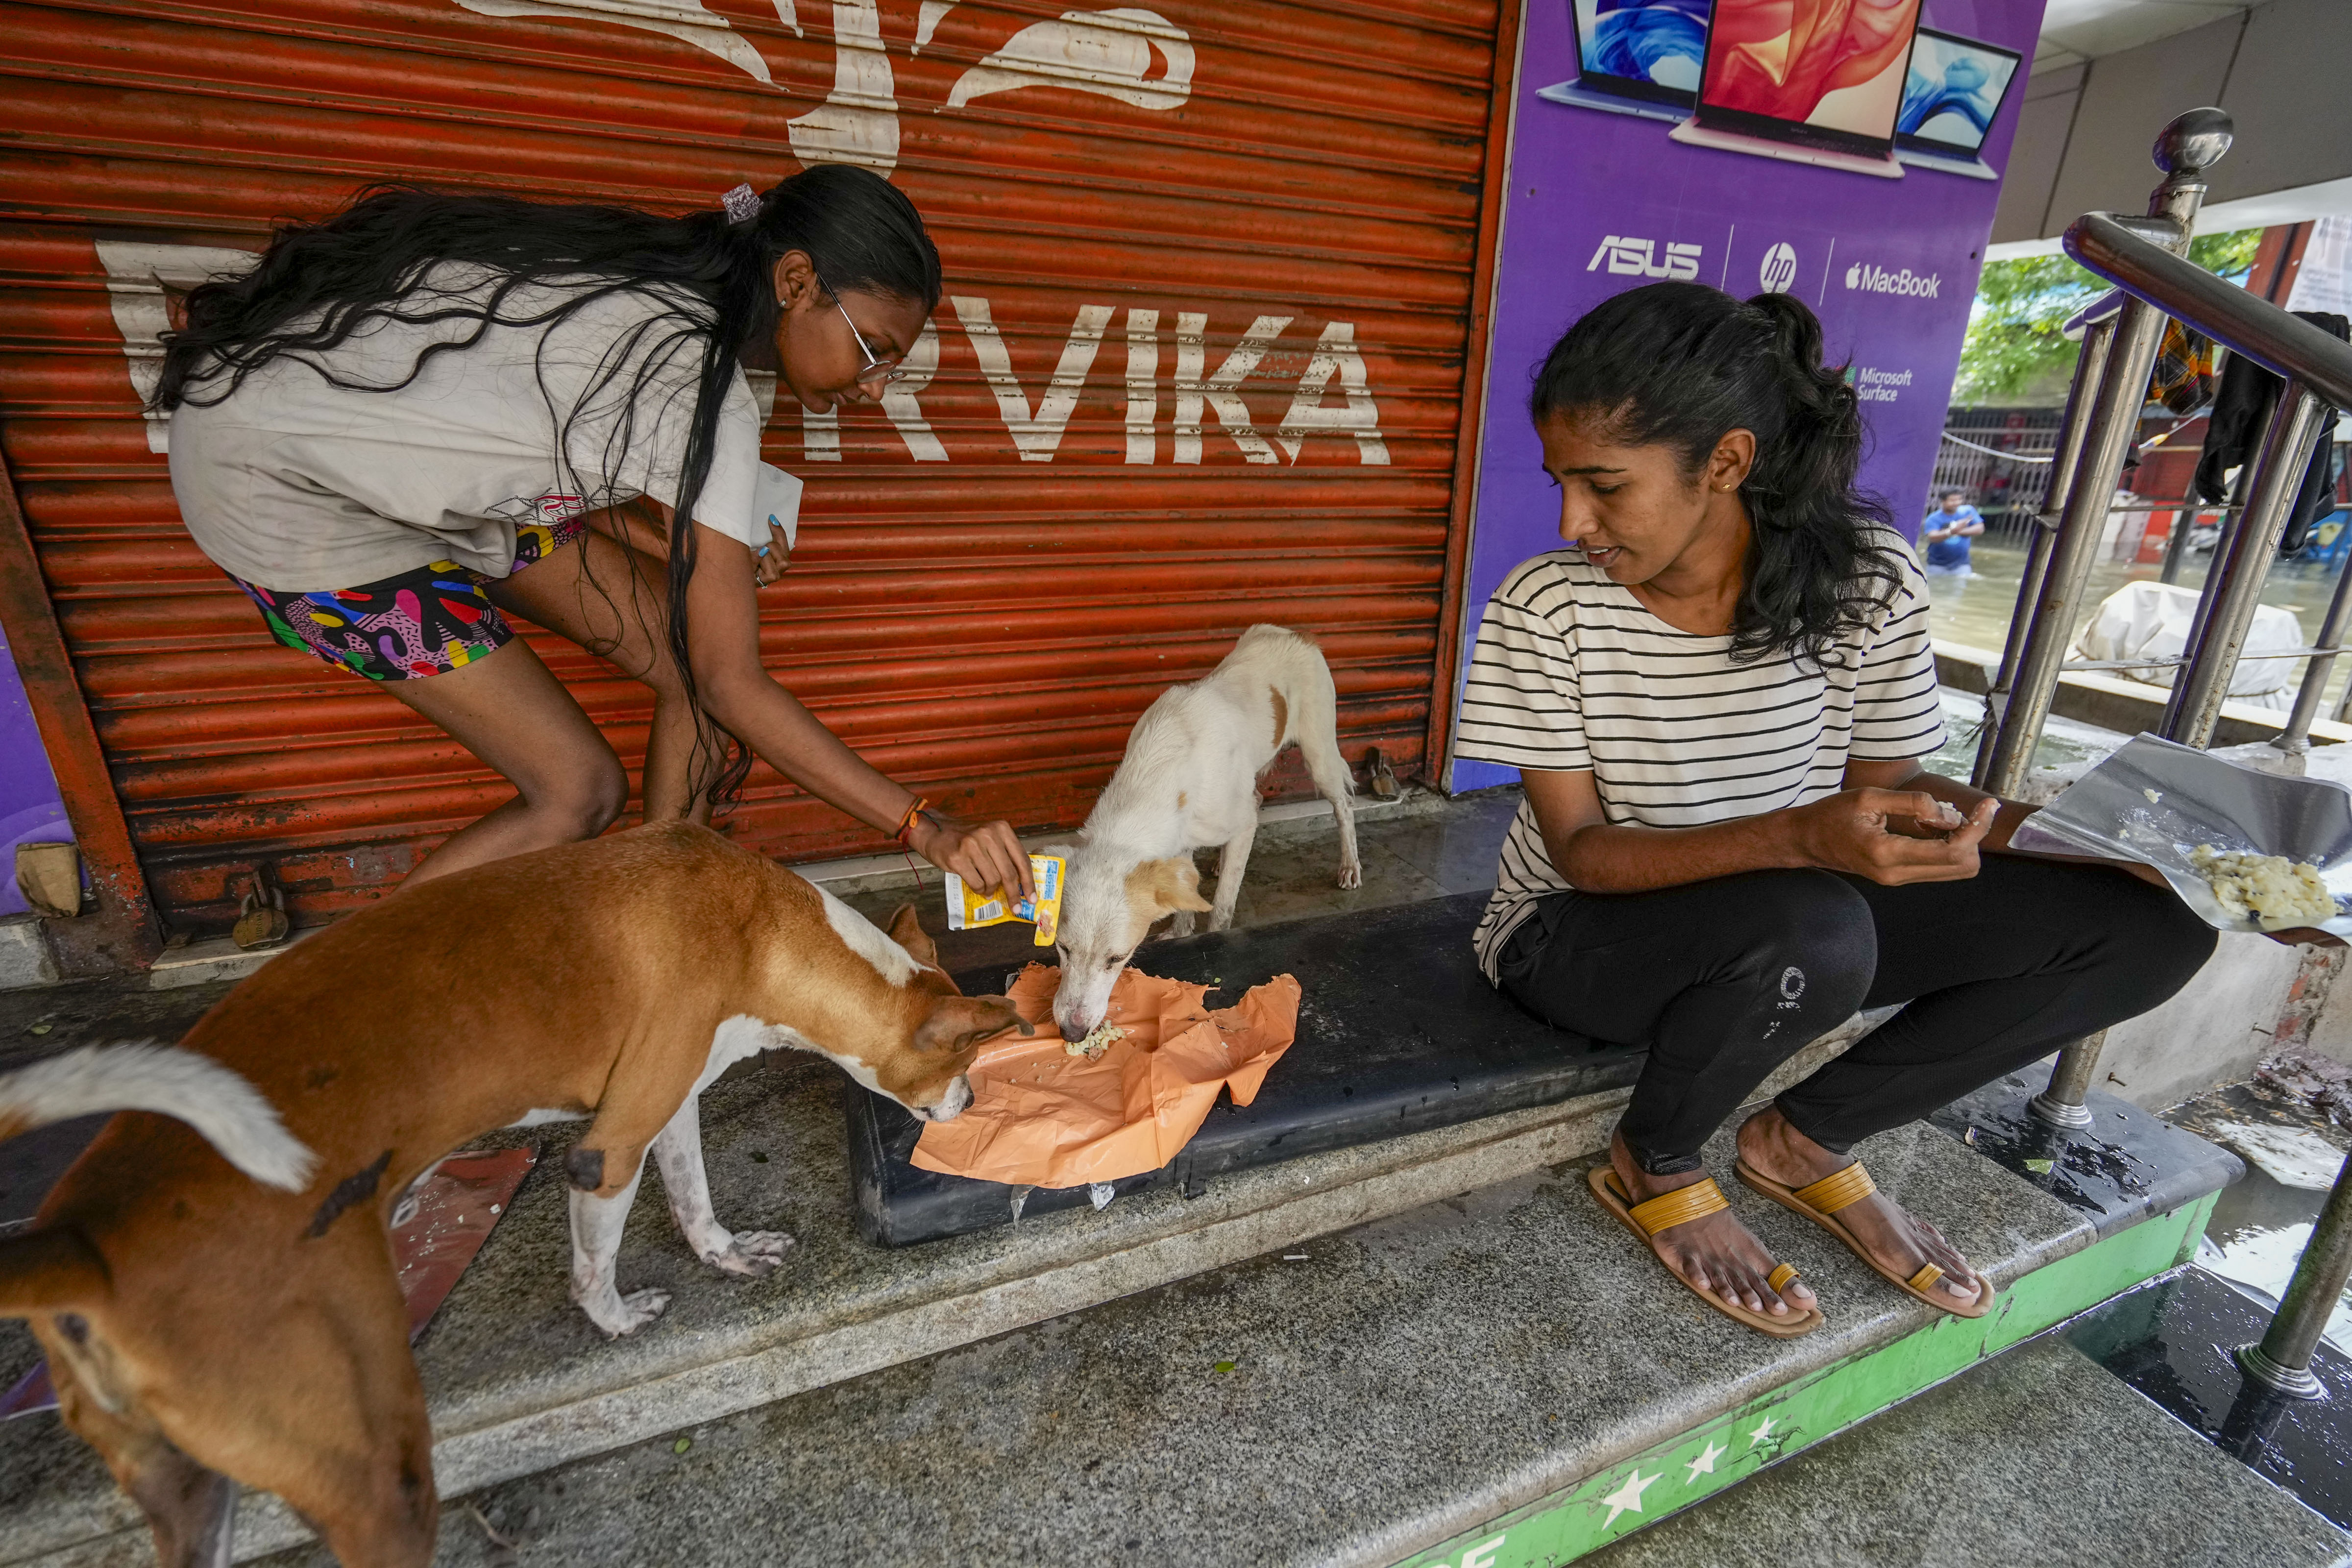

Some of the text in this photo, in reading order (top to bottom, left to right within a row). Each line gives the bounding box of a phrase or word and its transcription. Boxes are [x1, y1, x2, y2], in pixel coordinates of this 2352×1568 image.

[1587, 235, 1703, 280] ASUS
[1762, 243, 1795, 294] hp
[1861, 264, 1941, 298] MacBook
[1858, 384, 1898, 402] Surface
[1860, 368, 1912, 386] Microsoft
